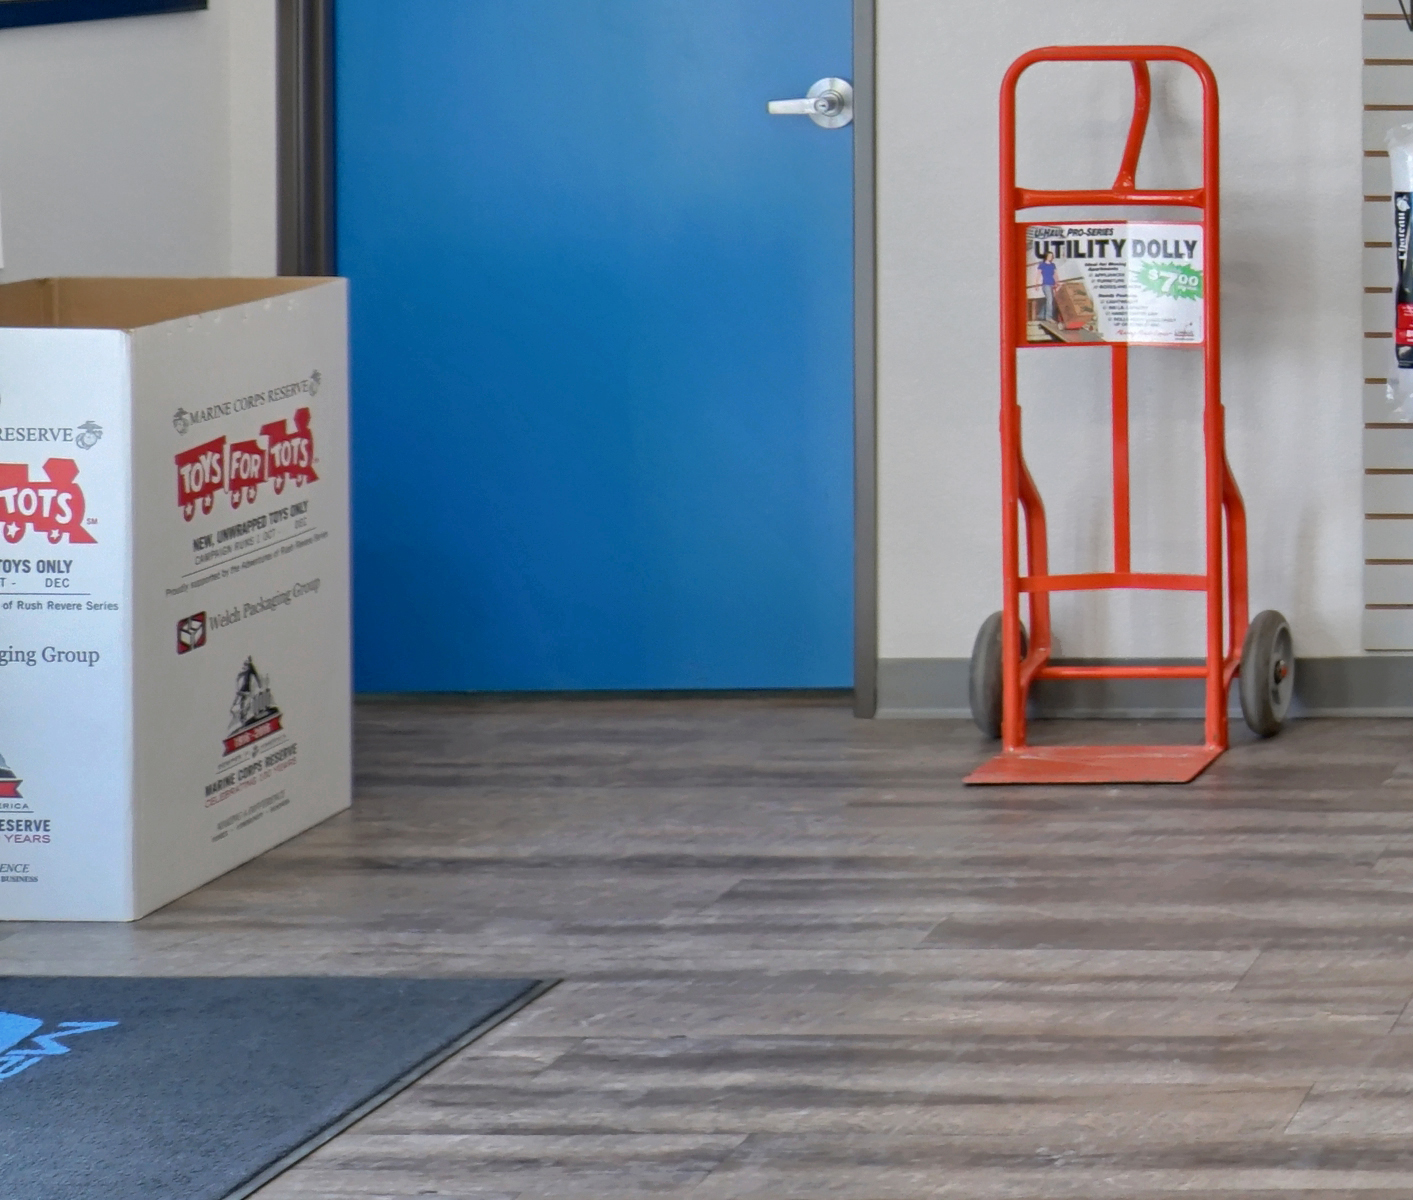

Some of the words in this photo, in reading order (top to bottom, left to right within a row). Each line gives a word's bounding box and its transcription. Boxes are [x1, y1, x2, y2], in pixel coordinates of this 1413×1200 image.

[1067, 228, 1114, 237] PRO-SERIES
[1034, 239, 1126, 259] UTILITY
[1131, 239, 1198, 260] DOLLY
[189, 402, 231, 425] MARINE
[233, 392, 266, 412] CORPS
[268, 380, 308, 402] RESERVE
[180, 451, 221, 493] TOYS
[231, 451, 261, 479] FOR
[271, 438, 308, 468] TOTS
[0, 488, 72, 524] TOTS
[193, 534, 214, 552] NEW,
[217, 515, 267, 543] UNWRAPPED
[269, 508, 289, 525] TOYS
[290, 500, 308, 517] ONLY
[37, 560, 72, 574] ONLY
[45, 578, 70, 588] DEC
[2, 601, 12, 610] of
[17, 601, 43, 611] Rush
[47, 601, 82, 611] Revere
[86, 601, 119, 612] Series
[209, 606, 240, 630] Welch
[243, 590, 292, 618] Packaging
[293, 578, 320, 598] Group
[42, 646, 100, 666] Group
[205, 773, 235, 797] MARINE
[238, 760, 262, 782] CORPS
[265, 743, 297, 766] RESERVE
[4, 834, 51, 844] YEARS
